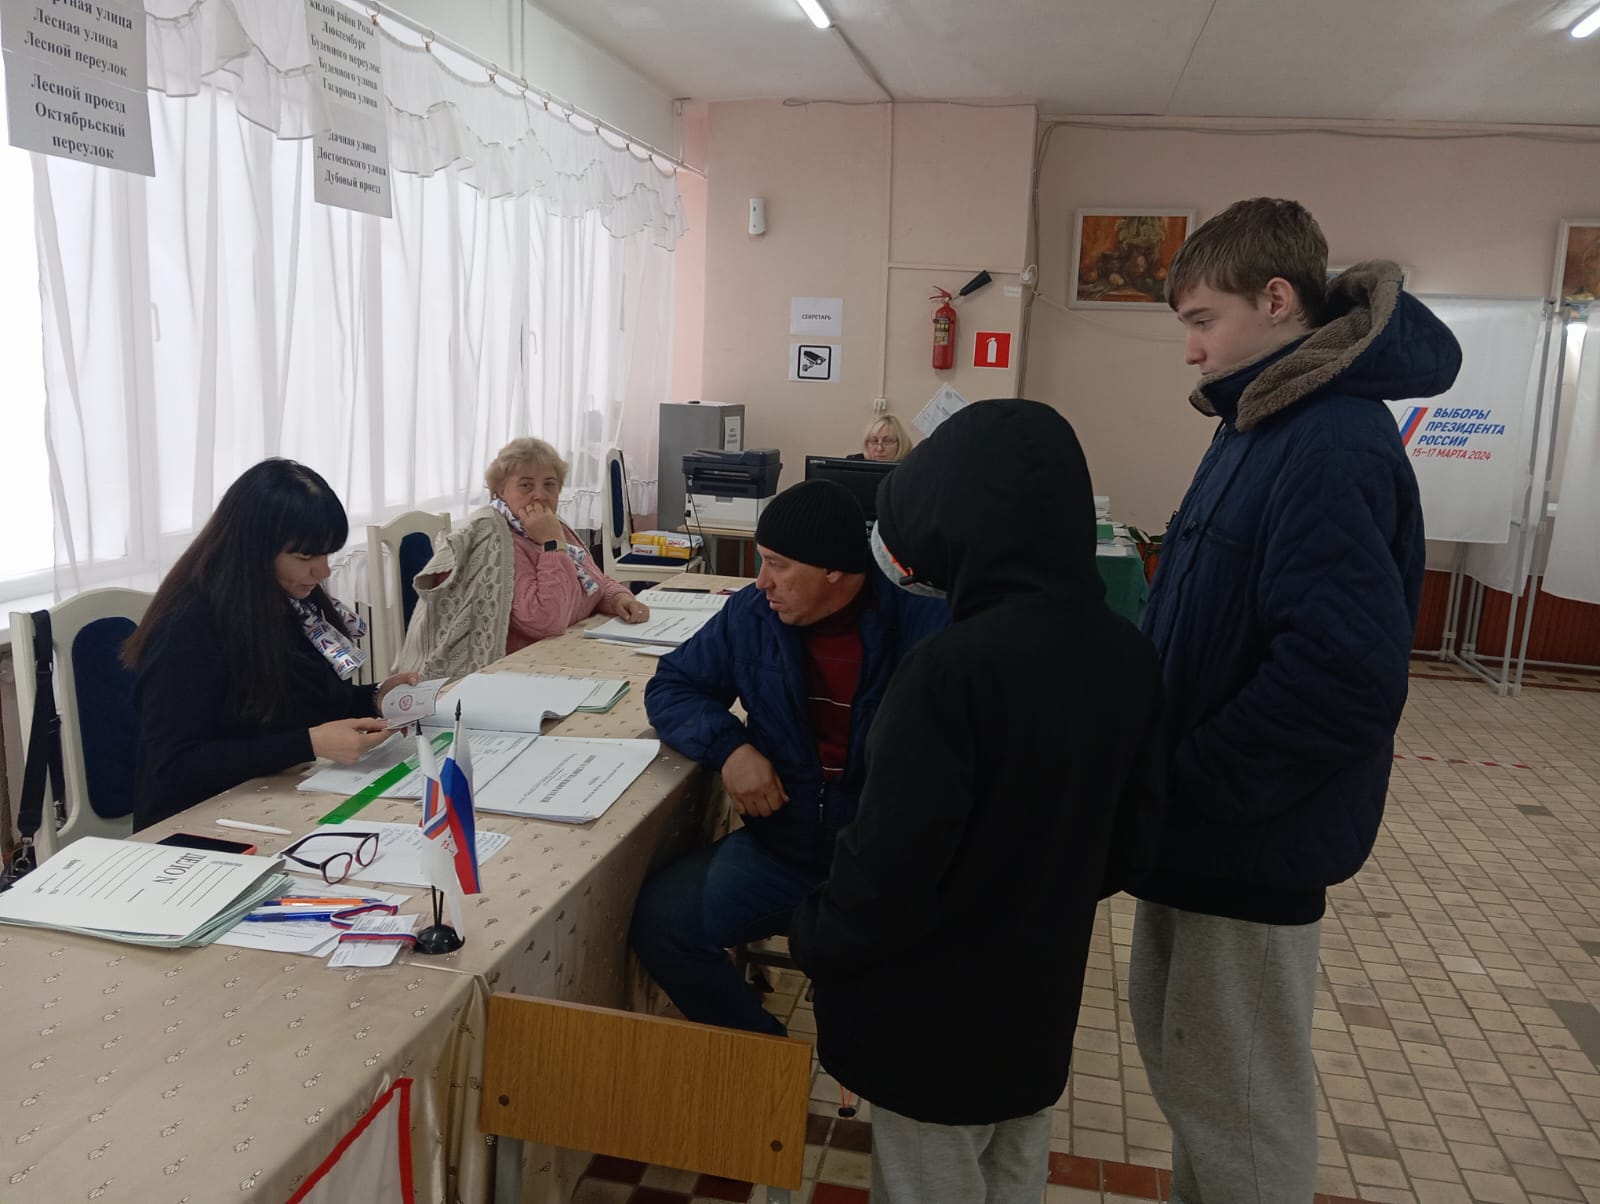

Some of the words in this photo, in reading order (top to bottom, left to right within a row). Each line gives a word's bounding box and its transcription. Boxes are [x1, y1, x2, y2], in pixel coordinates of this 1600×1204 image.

[33, 8, 80, 36] Лесная
[84, 28, 118, 50] улица
[96, 6, 133, 30] улица
[24, 30, 71, 58] Лесной
[75, 50, 128, 78] переулок
[31, 73, 81, 101] Лесной
[84, 92, 126, 114] проезд
[35, 102, 126, 137] Октябрьский
[52, 135, 115, 160] переулок
[317, 146, 367, 170] Достоевского
[801, 313, 832, 321] СЕКРЕТАРЬ
[1432, 407, 1492, 420] ВЫБОРЫ
[1425, 421, 1506, 435] ПРЕЗИДЕНТА
[1417, 435, 1470, 447] РОССИИ
[1436, 448, 1467, 459] МАРТА
[1467, 450, 1492, 460] 2024
[163, 852, 208, 876] ДЕЛО
